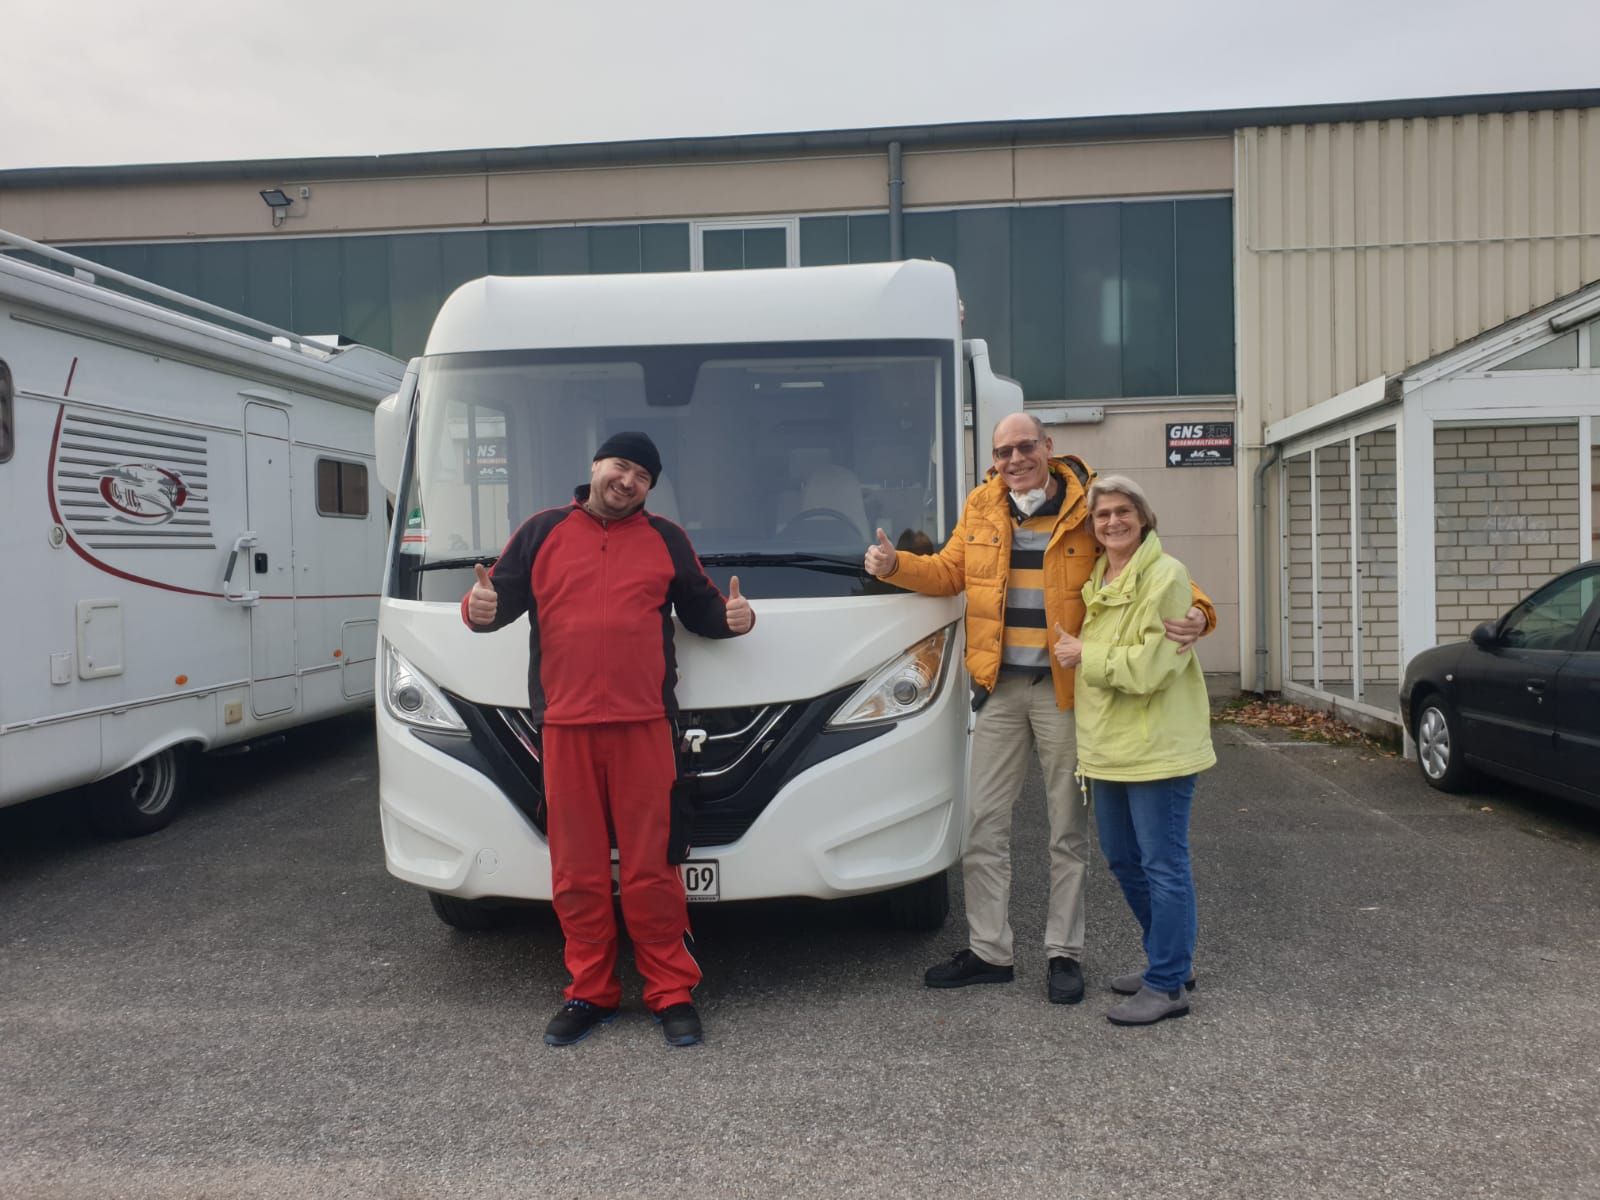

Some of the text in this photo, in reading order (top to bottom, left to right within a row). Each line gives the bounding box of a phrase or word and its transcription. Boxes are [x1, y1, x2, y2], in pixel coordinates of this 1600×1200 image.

[1170, 425, 1203, 439] GNS
[467, 445, 497, 457] NS
[686, 867, 714, 892] 09
